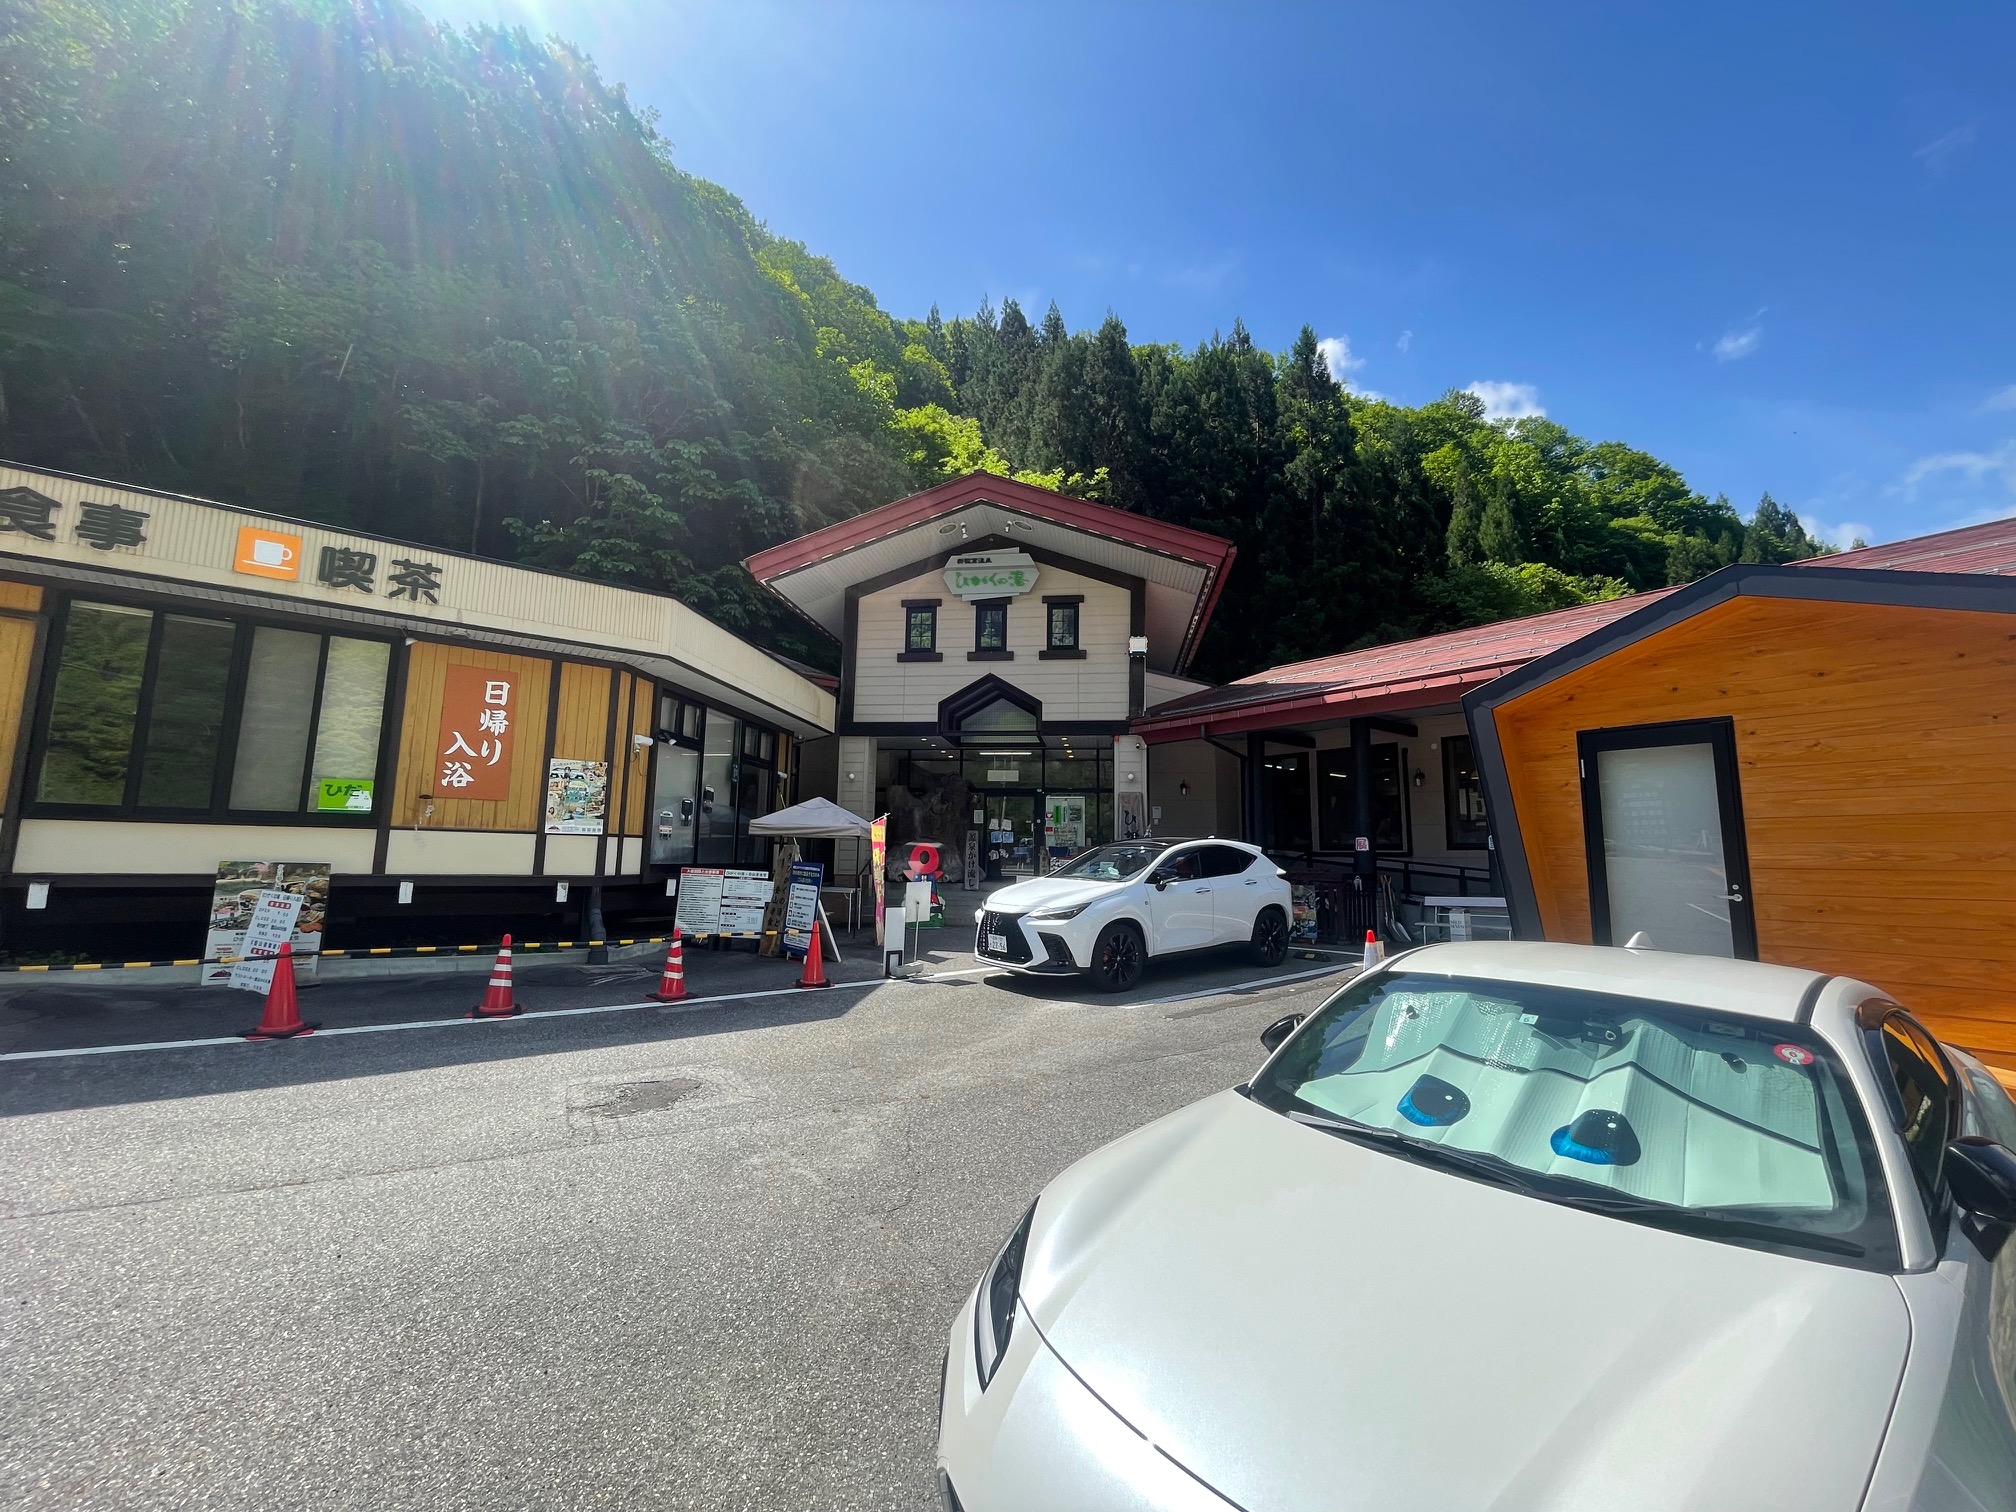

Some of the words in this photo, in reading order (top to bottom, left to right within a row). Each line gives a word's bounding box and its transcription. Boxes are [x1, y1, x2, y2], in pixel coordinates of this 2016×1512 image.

[0, 486, 150, 550] 食事
[319, 545, 443, 604] 喫茶
[478, 680, 511, 766] 日帰り
[441, 731, 478, 787] 入浴
[967, 831, 977, 887] 源泉かけ流し
